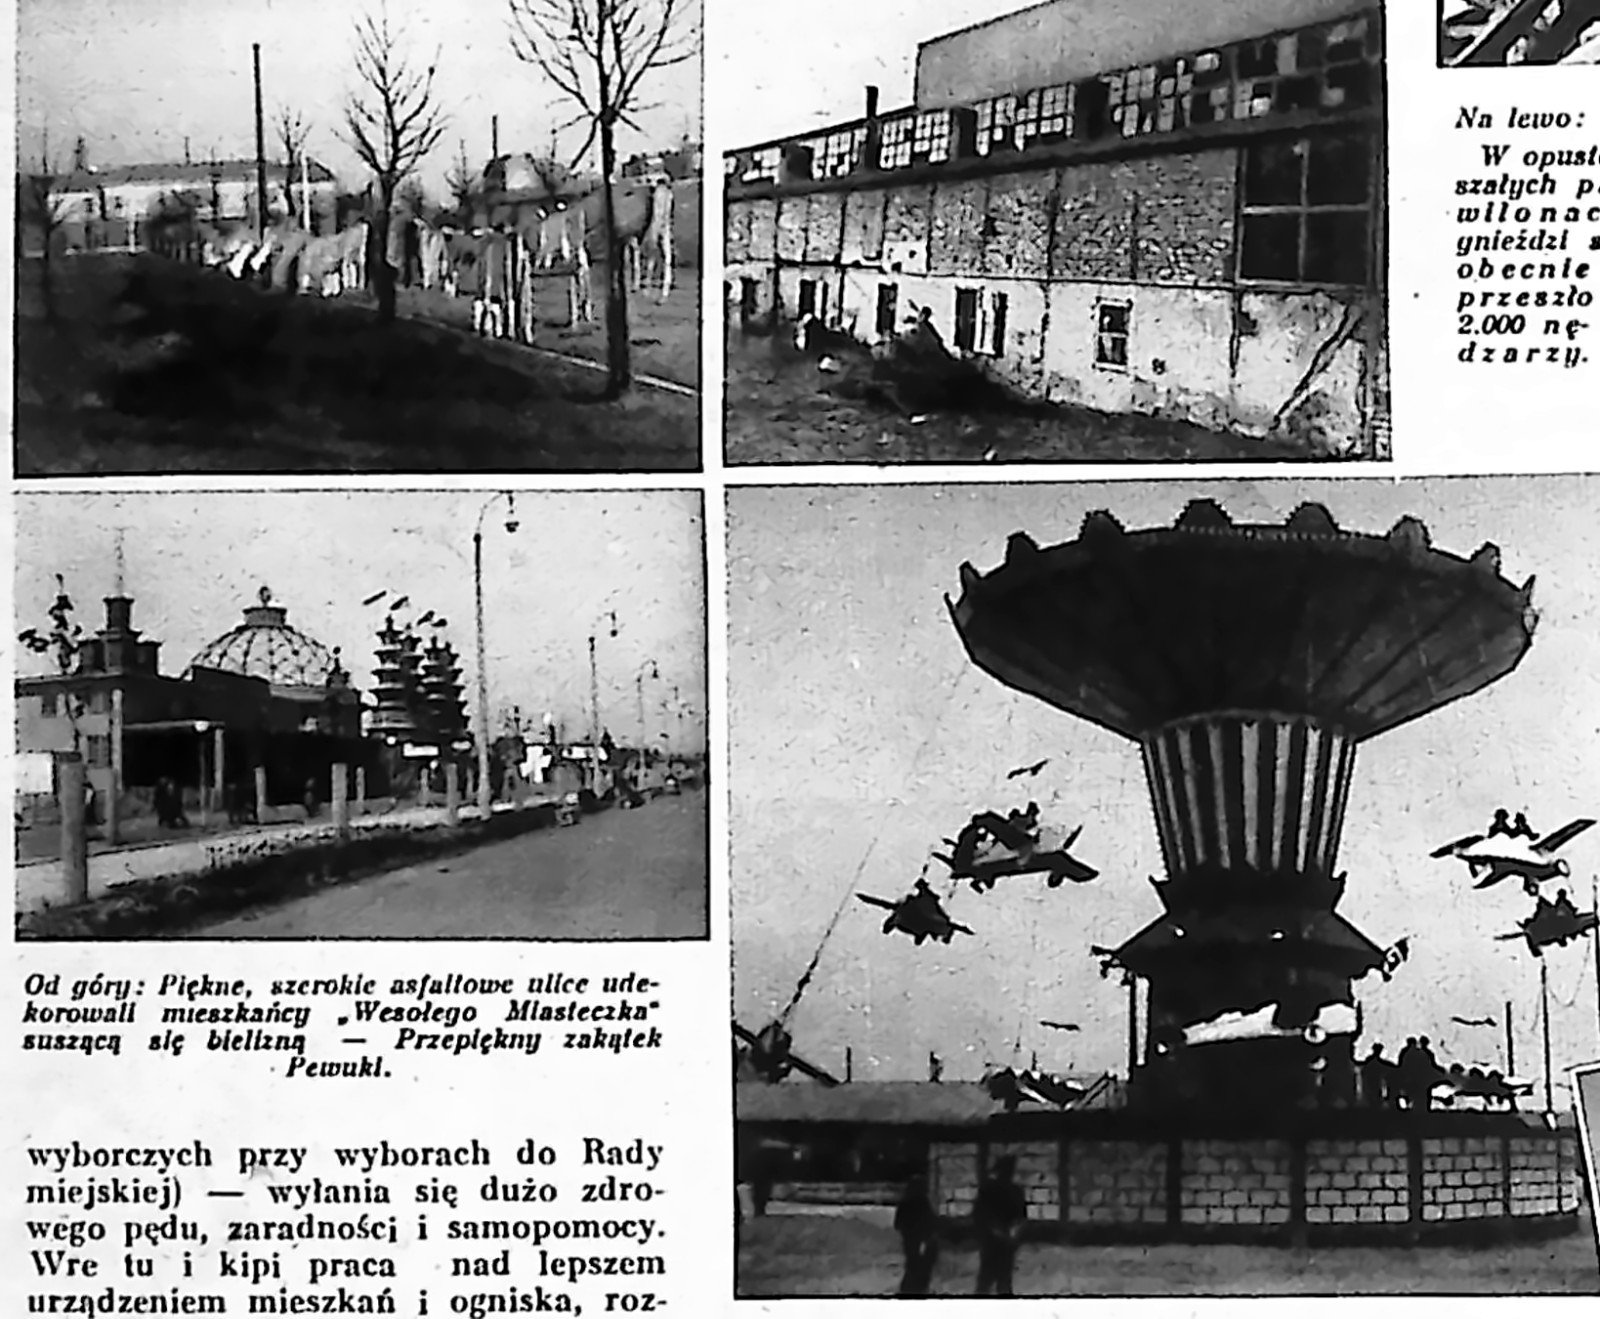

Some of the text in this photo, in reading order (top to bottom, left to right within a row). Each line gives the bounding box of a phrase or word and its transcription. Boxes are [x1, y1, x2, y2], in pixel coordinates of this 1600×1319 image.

[1455, 106, 1585, 130] Na lewo:
[1481, 144, 1600, 173] W opust
[1455, 228, 1569, 257] gnieździ
[1456, 257, 1590, 280] obecnie
[1456, 284, 1593, 314] przeszło
[1457, 313, 1589, 341] 2.000 nę-
[1457, 340, 1588, 369] dzarzy.
[24, 971, 660, 1002] Od góry: Piękne, szerokie asfaltowe ulice ude-
[22, 1000, 136, 1024] korowali
[161, 1000, 311, 1029] mieszkańcy
[22, 1034, 122, 1056] suszącą
[148, 1029, 185, 1057] się
[206, 1028, 306, 1056] bielizną
[394, 1027, 542, 1056] Przepiękny
[563, 1026, 663, 1055] zakątek
[285, 1055, 392, 1078] Pewuki.
[27, 1137, 664, 1175] wyborczych przy wyborach do Rady
[26, 1176, 181, 1211] miejskiej)
[267, 1177, 391, 1210] wyłania
[415, 1177, 458, 1209] się
[480, 1175, 558, 1203] dużo
[581, 1175, 664, 1203] zdro-
[26, 1213, 665, 1248] wego pędu, zaradności i samopomocy.
[30, 1249, 666, 1285] Wre tu i kipi praca nad lepszem
[28, 1285, 667, 1319] urządzeniem mieszkań i ogniska, roz-
